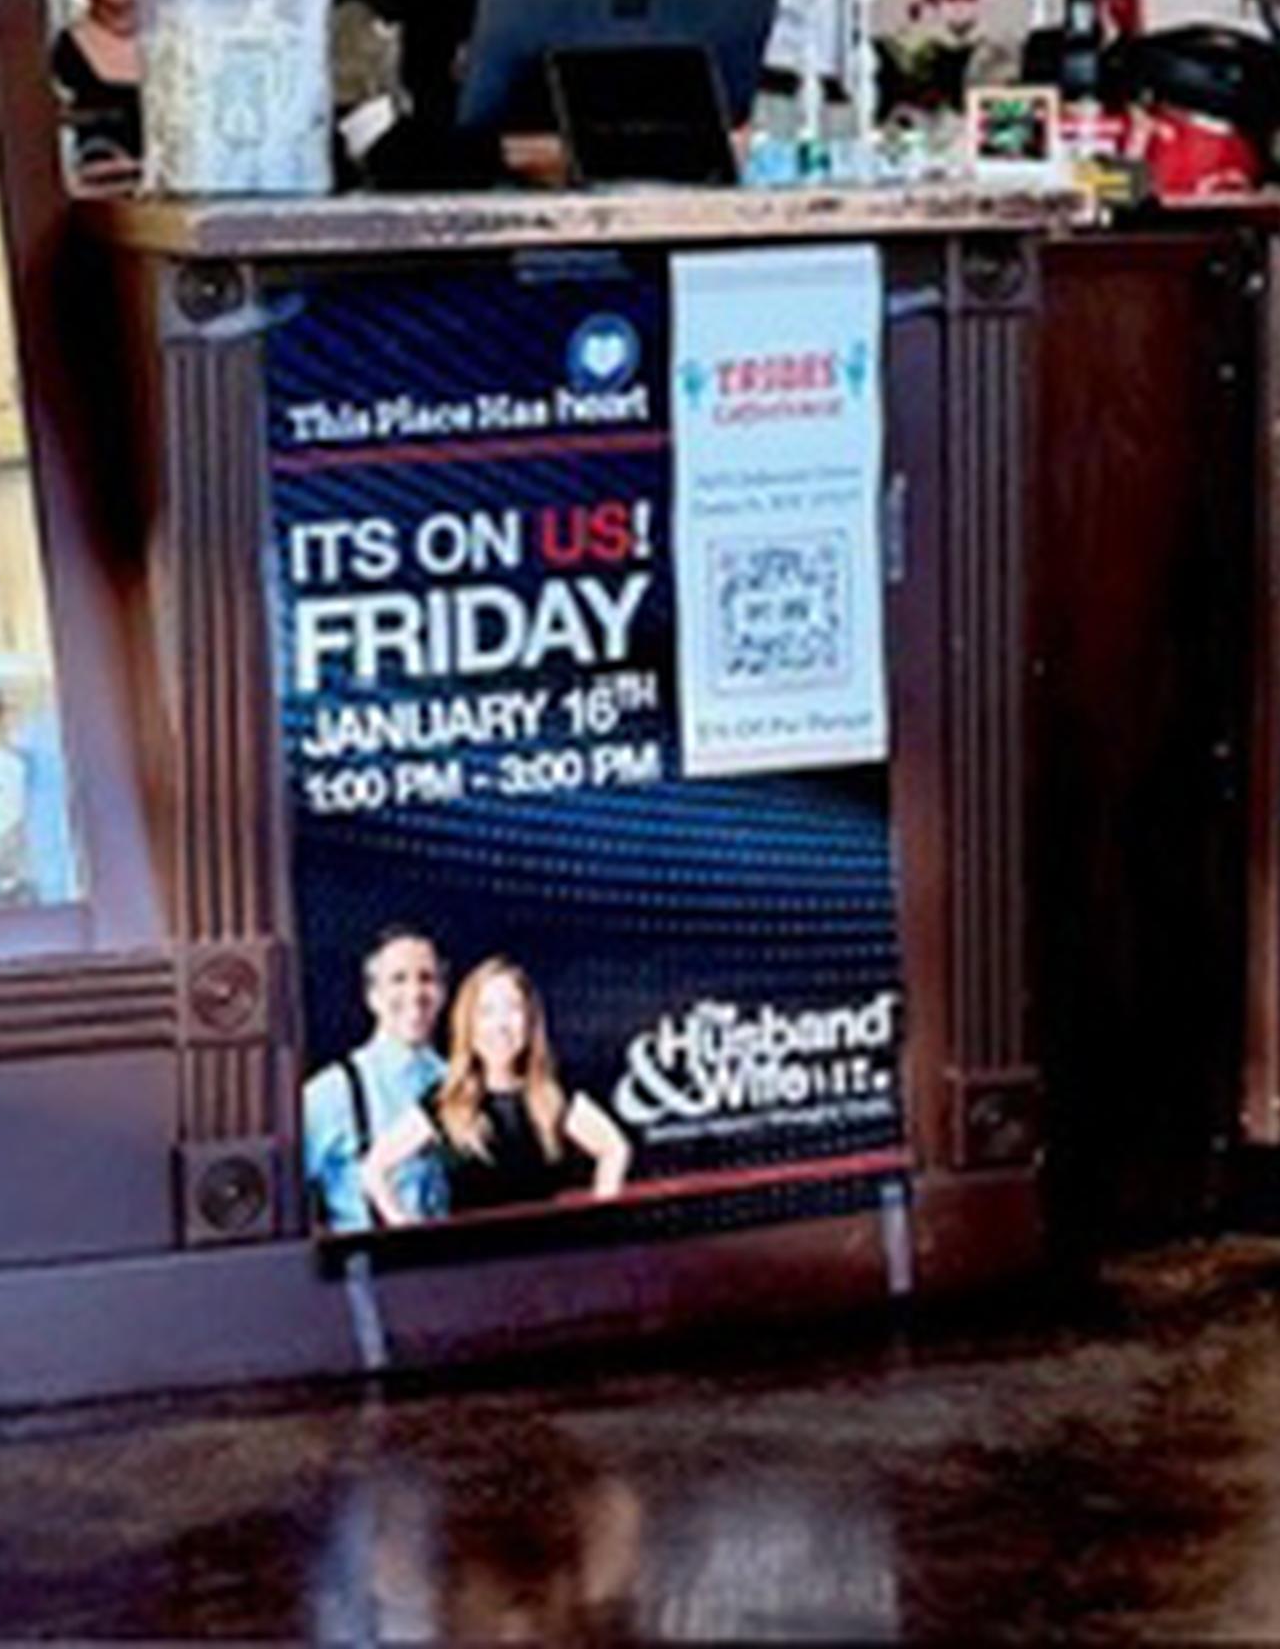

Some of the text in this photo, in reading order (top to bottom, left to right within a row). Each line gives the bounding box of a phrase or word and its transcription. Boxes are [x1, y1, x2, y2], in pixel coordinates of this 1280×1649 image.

[287, 401, 371, 442] This
[372, 394, 472, 436] Place
[475, 392, 549, 430] Has
[290, 517, 402, 584] ITS
[416, 508, 520, 577] ON
[540, 499, 652, 569] US!
[294, 573, 653, 693] FRIDAY
[300, 687, 548, 758] JANUARY
[304, 766, 390, 814] 1:00
[395, 756, 465, 805] PM
[496, 749, 585, 796] 3:00
[590, 741, 663, 787] PM
[657, 991, 898, 1071] Husband
